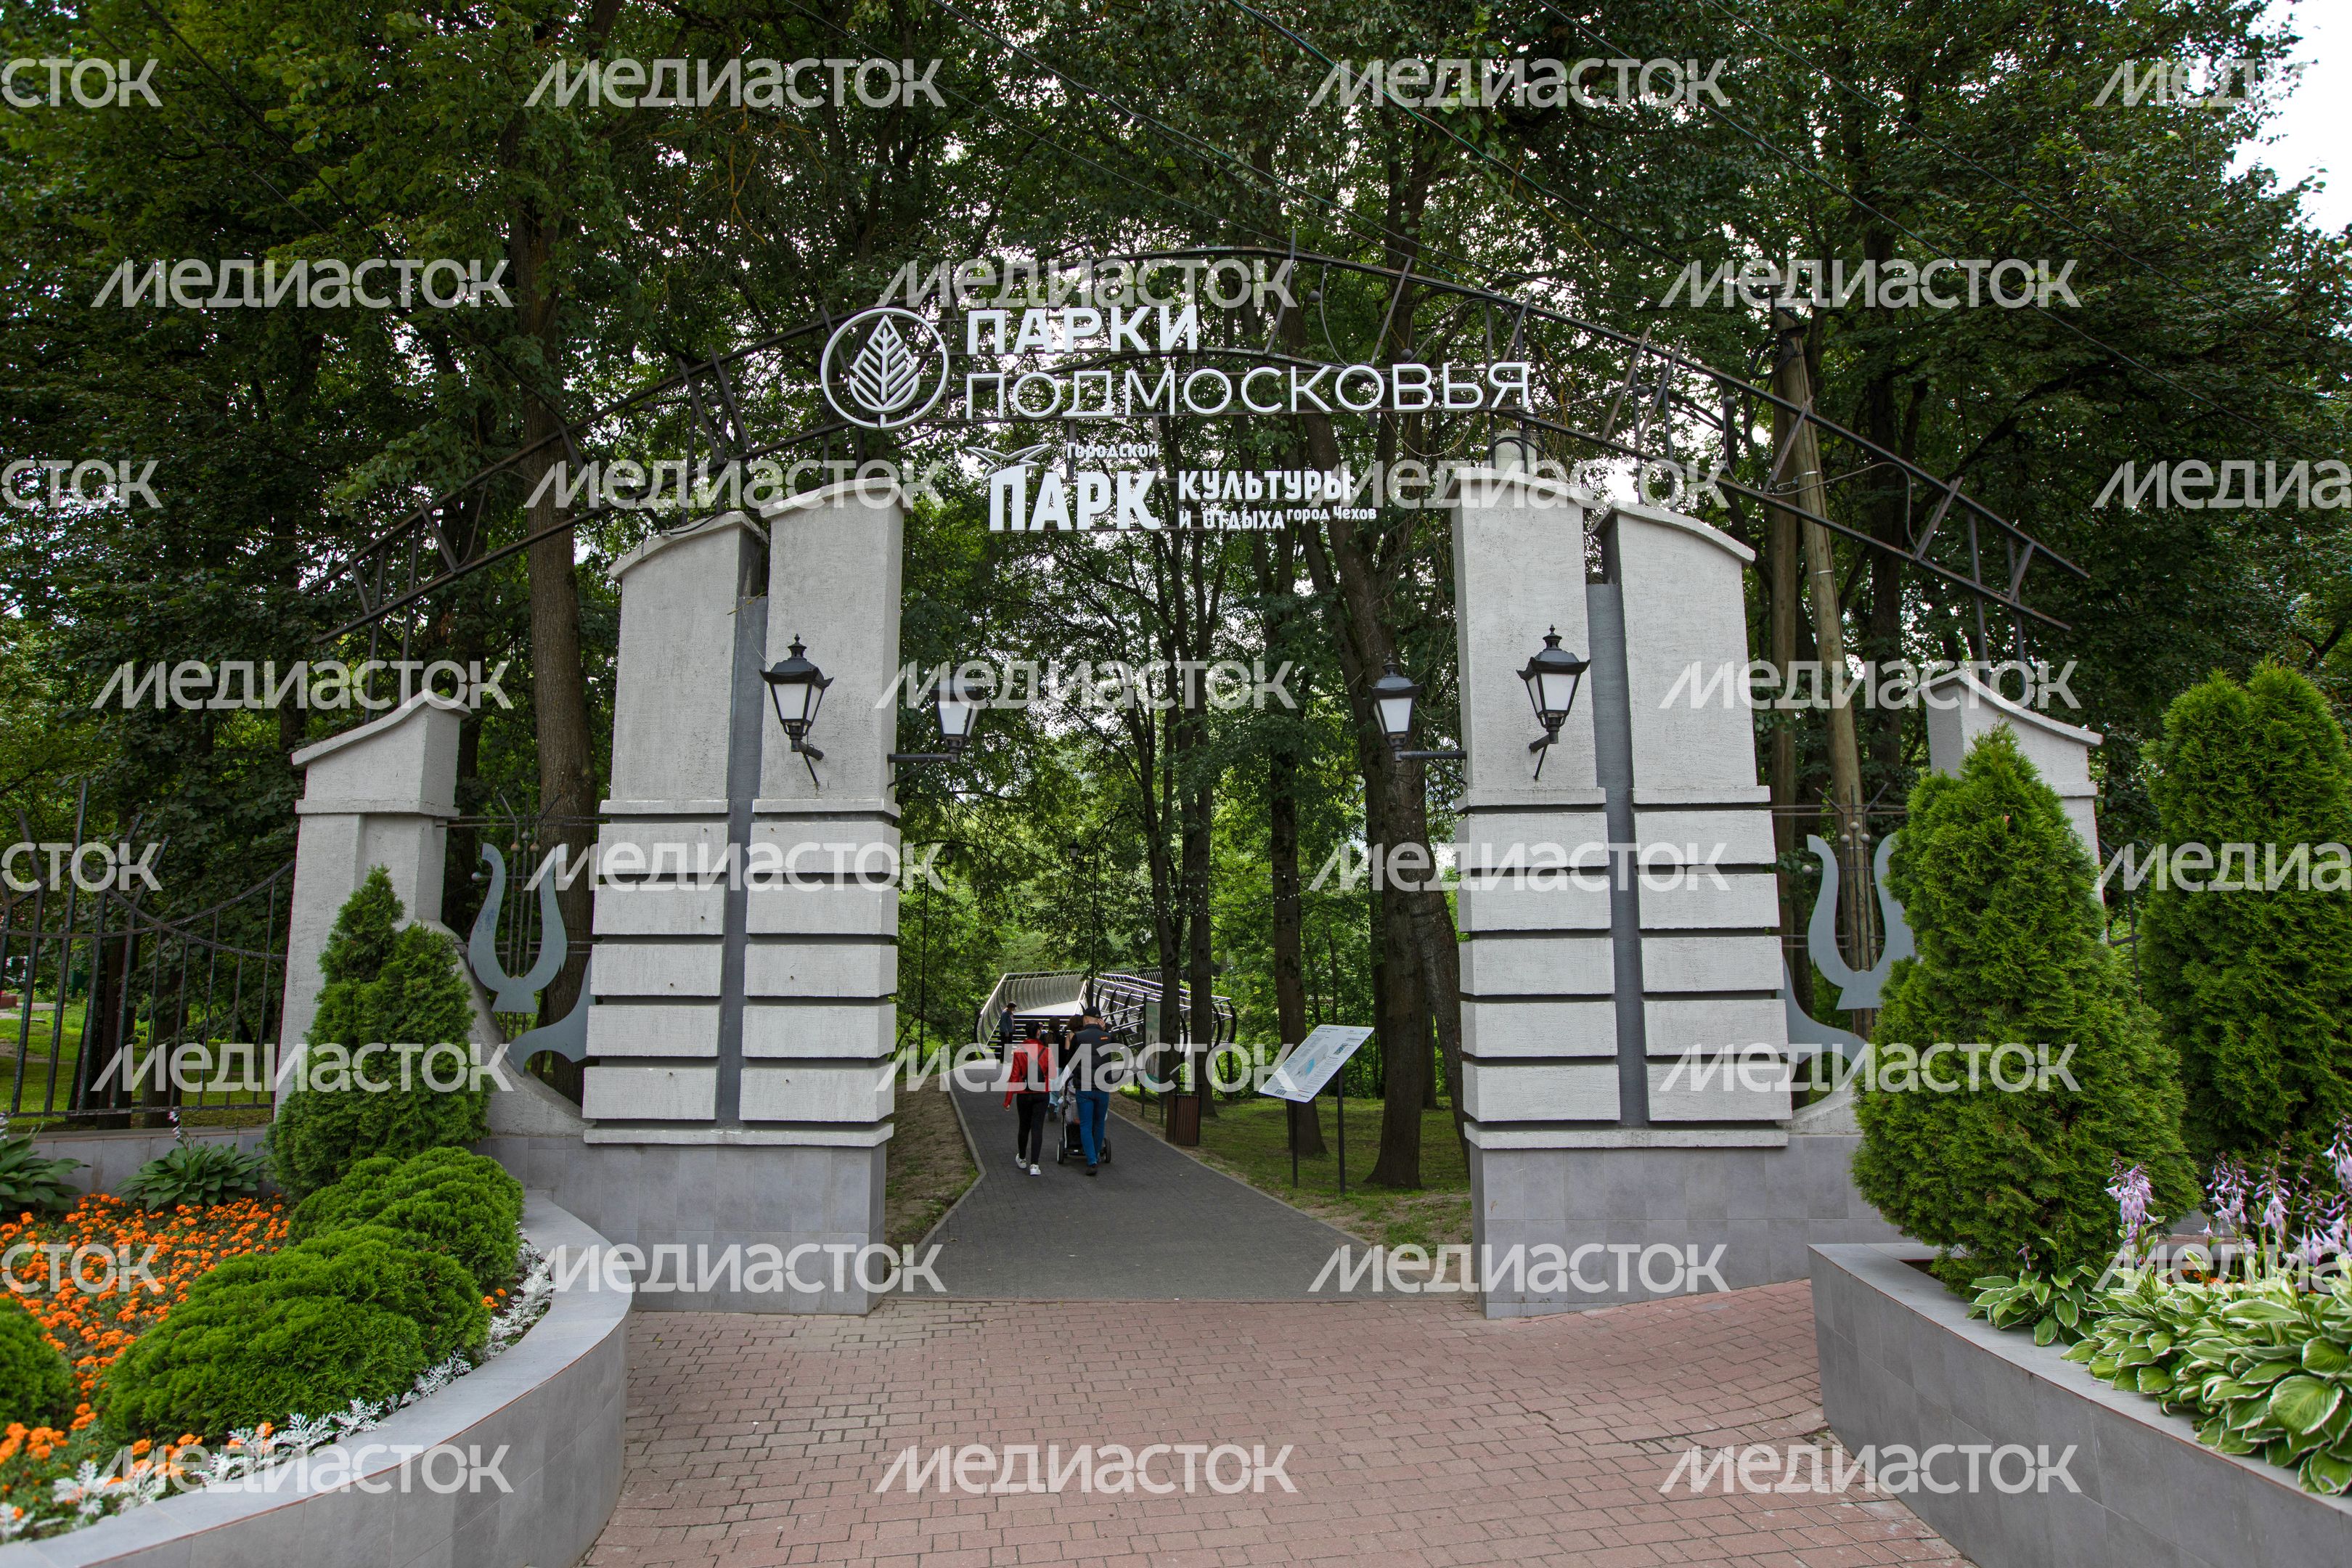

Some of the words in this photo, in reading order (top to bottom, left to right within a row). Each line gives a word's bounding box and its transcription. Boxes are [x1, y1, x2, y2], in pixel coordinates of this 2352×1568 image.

[967, 305, 1198, 355] ПАРКИ
[965, 362, 1530, 420] ПОДМОСКОВЬЯ
[1066, 442, 1159, 461] Городской
[987, 465, 1163, 533] ПАРК
[1178, 470, 1351, 502] КУЛЬТУРЫ
[1203, 510, 1285, 532] ОТДЫХА
[1333, 505, 1377, 520] Чехов
